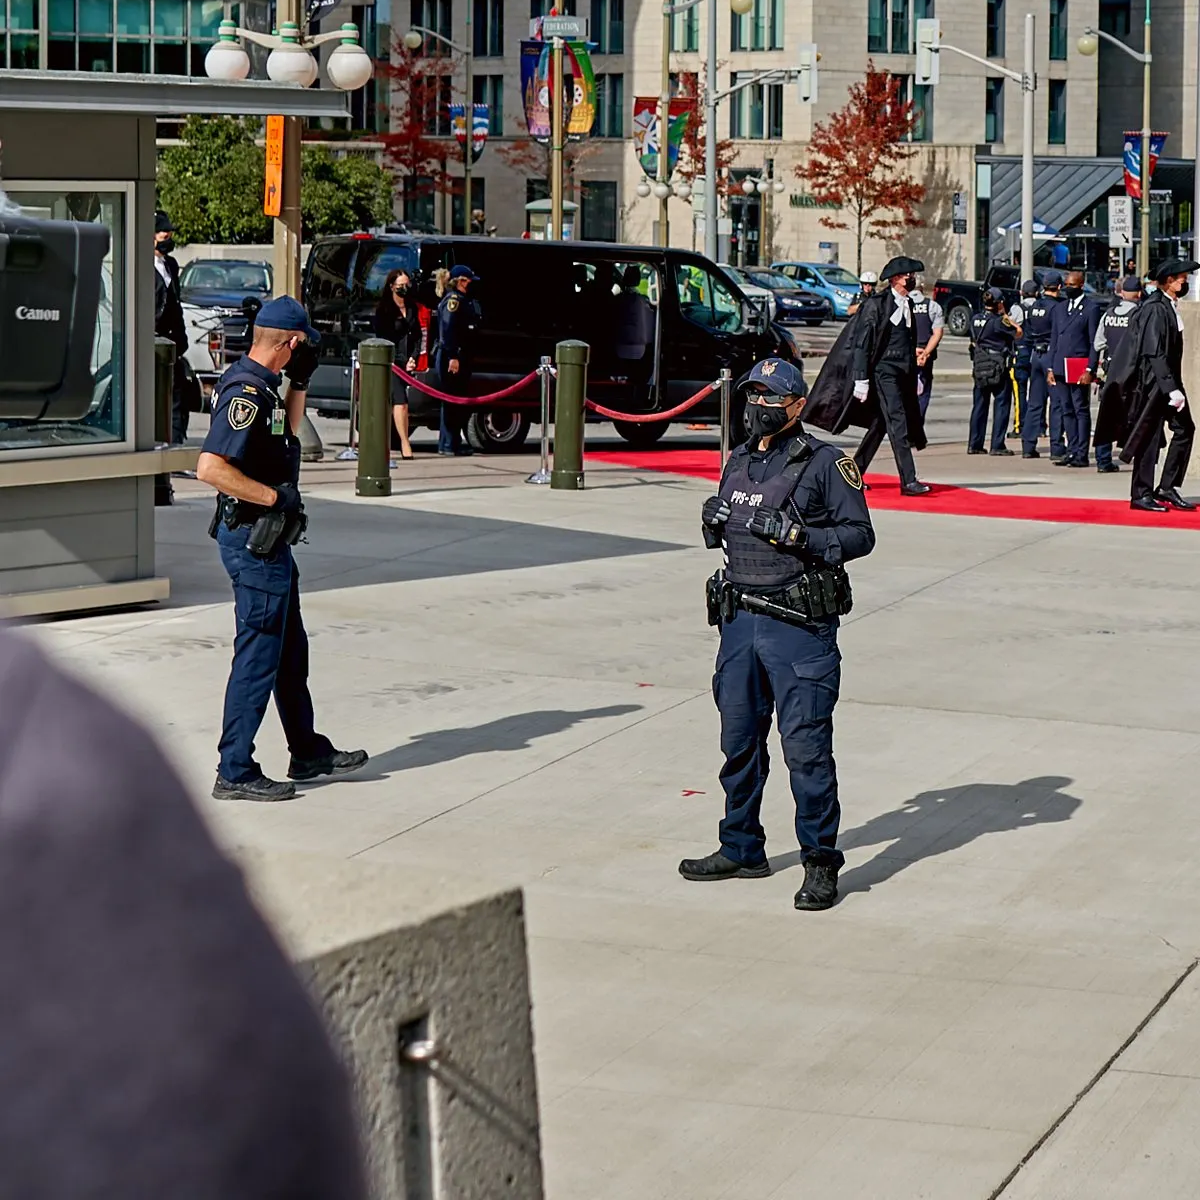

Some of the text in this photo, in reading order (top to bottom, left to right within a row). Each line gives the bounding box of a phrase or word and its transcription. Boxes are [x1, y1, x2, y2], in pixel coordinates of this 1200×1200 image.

[543, 21, 580, 33] FEDERATION
[789, 194, 843, 210] MILES
[15, 305, 60, 321] Canon
[912, 303, 928, 314] LICE
[1104, 315, 1129, 328] POLICE
[730, 489, 764, 507] PPS-SPP
